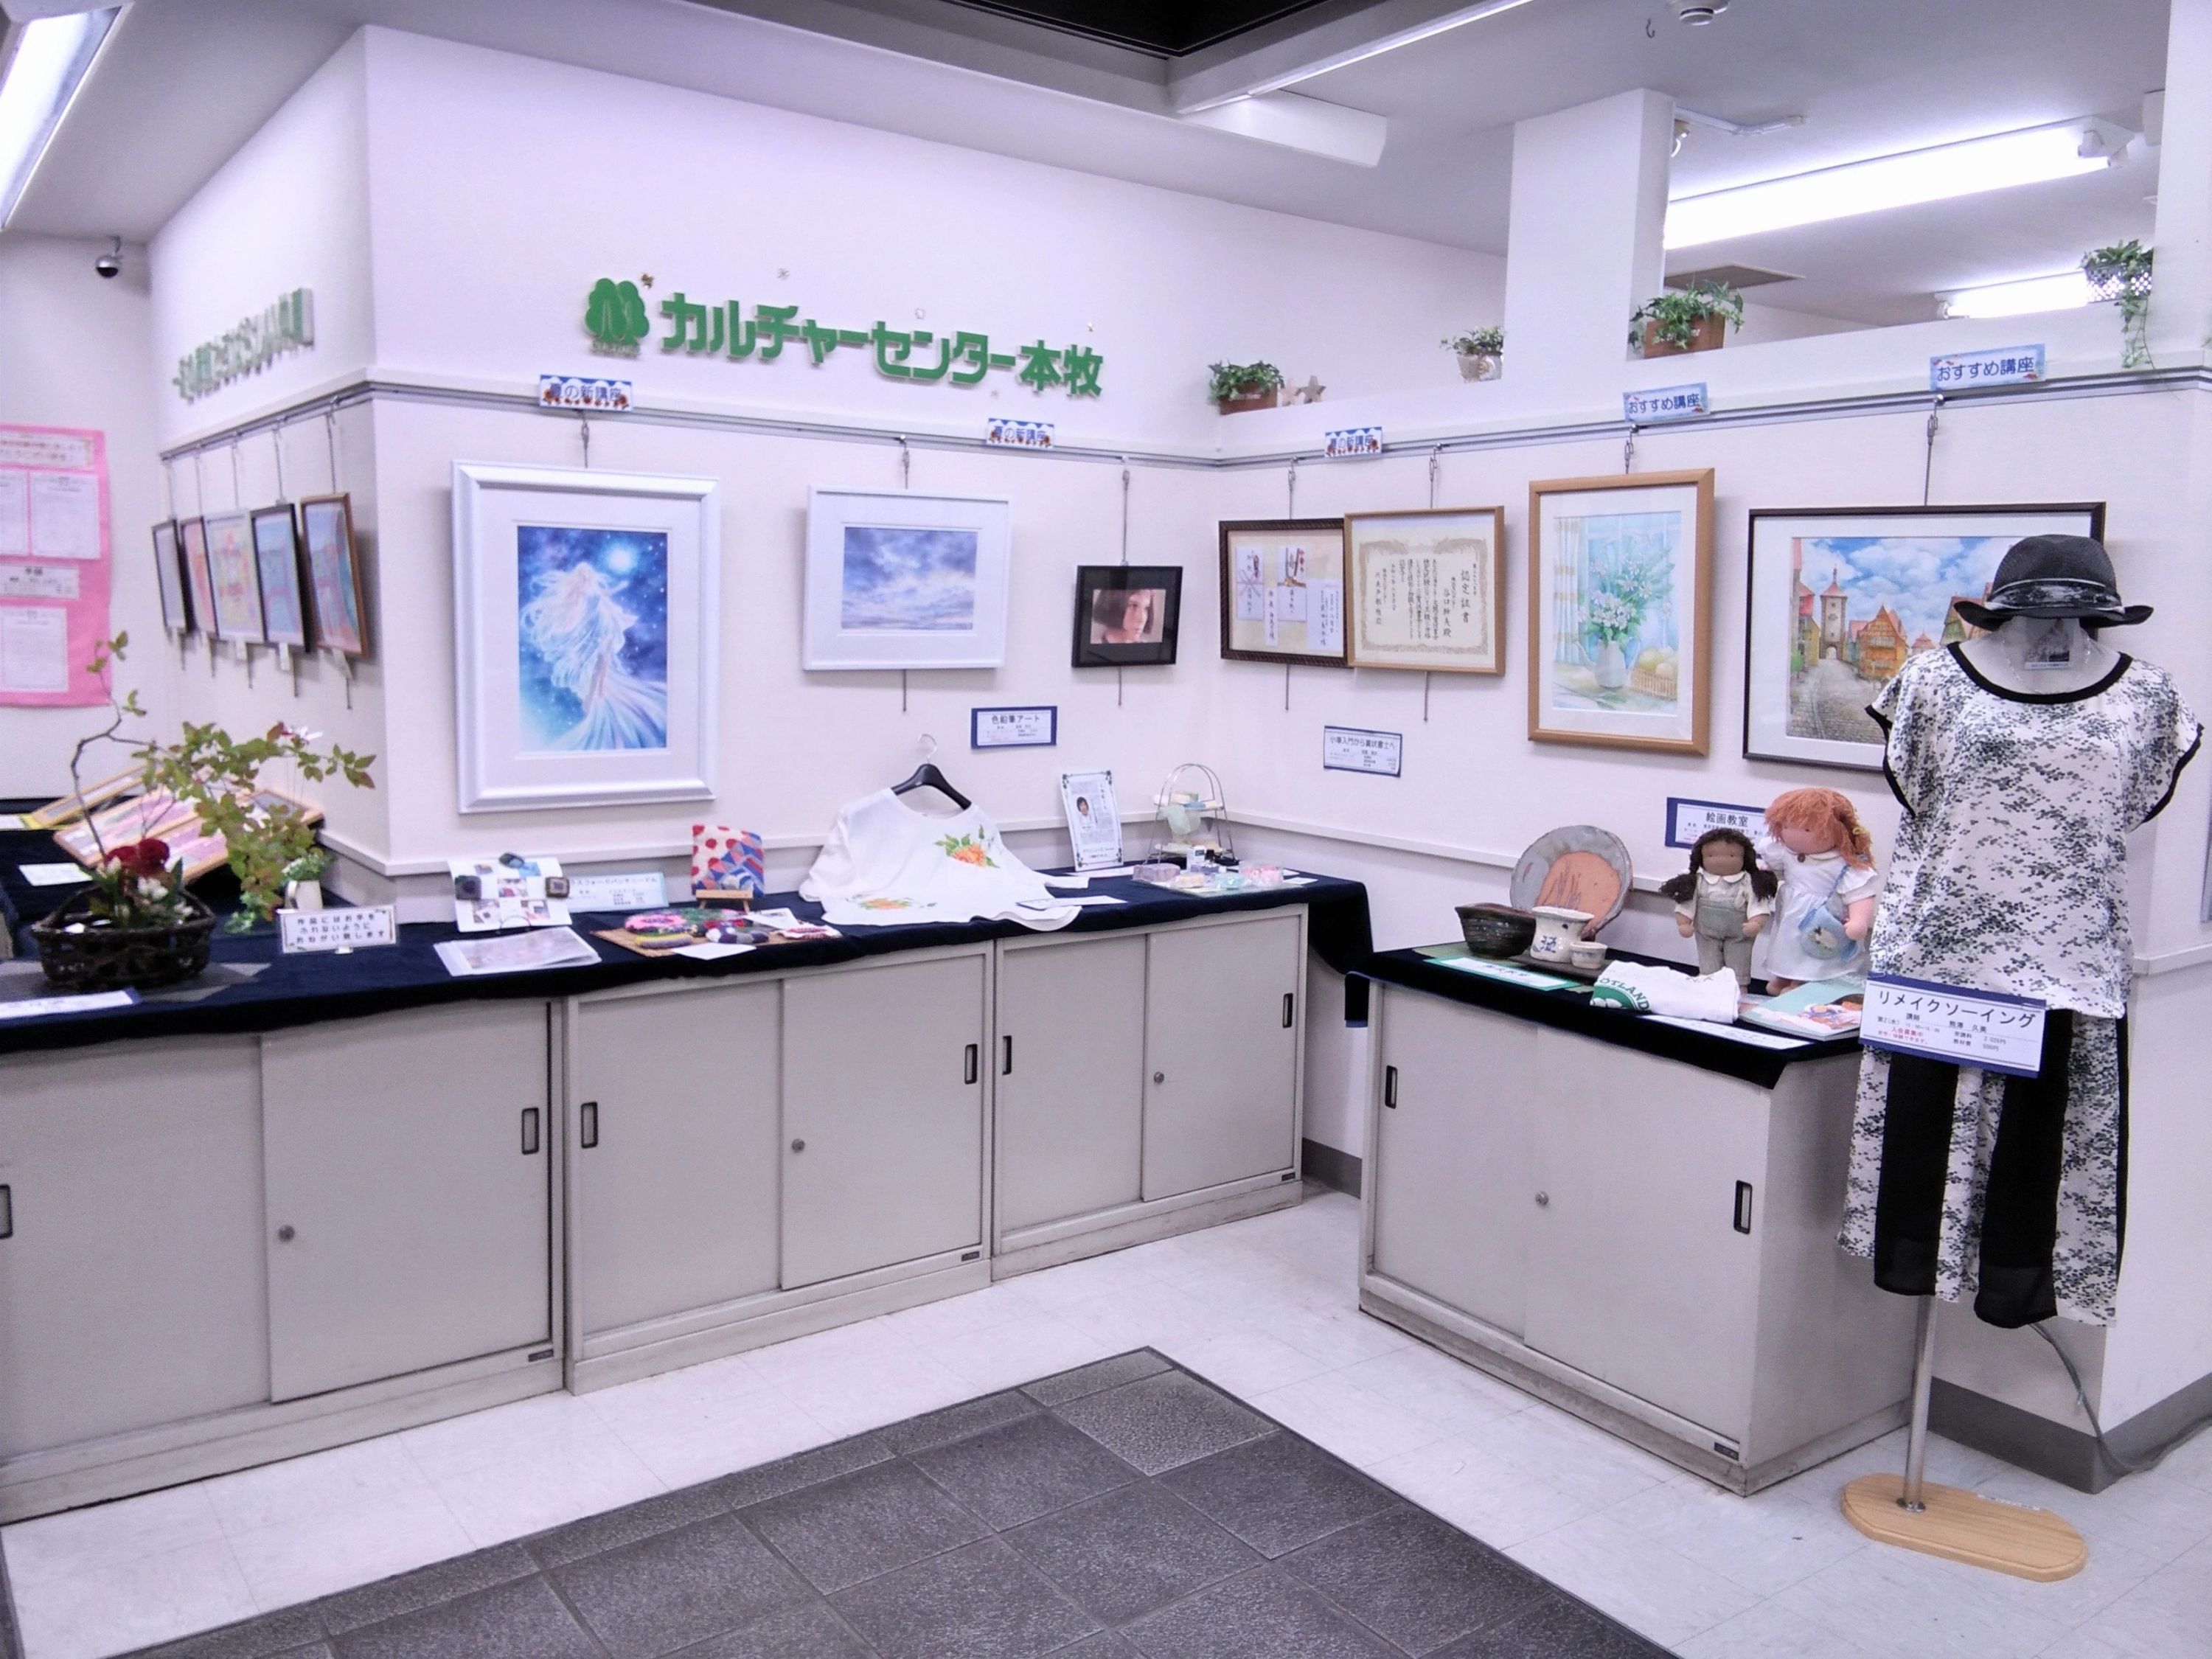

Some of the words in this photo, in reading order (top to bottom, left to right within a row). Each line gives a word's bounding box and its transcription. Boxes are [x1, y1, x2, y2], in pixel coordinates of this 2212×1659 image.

[660, 292, 1104, 397] カルチャーセンター本牧
[1936, 356, 2035, 382] おすすめ講座
[1629, 393, 1700, 414] おすすめ講座
[991, 714, 1040, 724] 色鉛筆アート
[1705, 812, 1749, 827] 絵画教室
[297, 914, 375, 925] 作品にはお手を
[300, 922, 370, 934] ふれないように
[1879, 990, 2037, 1029] リメイクソーイング
